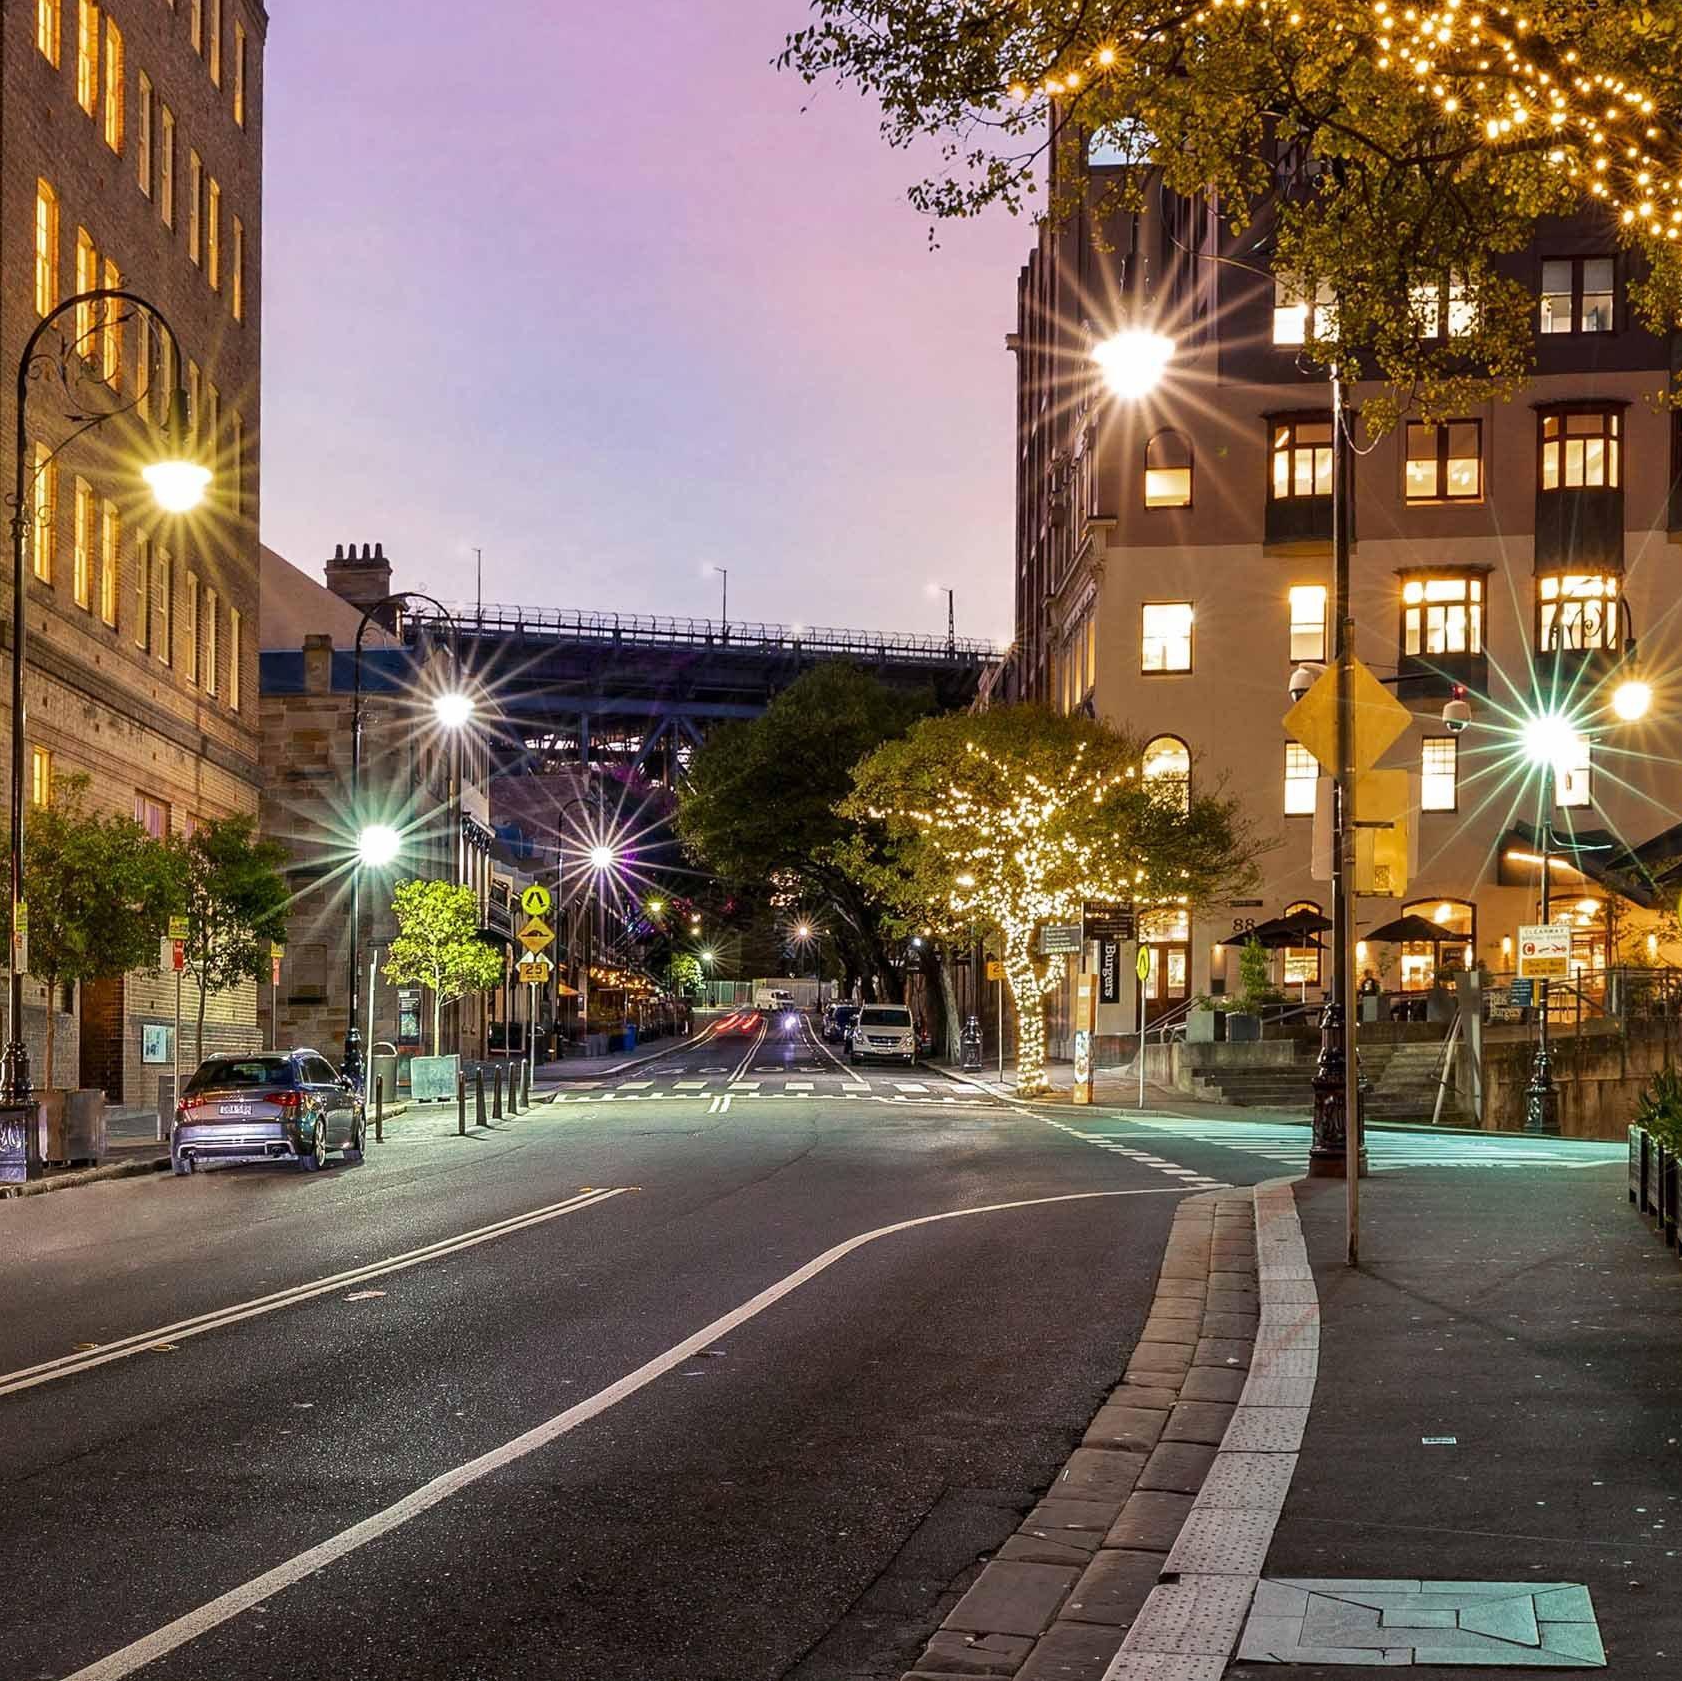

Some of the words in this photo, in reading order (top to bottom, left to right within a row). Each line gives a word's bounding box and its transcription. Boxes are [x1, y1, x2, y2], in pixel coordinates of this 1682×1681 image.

[1233, 918, 1255, 931] 88
[525, 964, 543, 975] 25
[1101, 943, 1116, 998] Burgers
